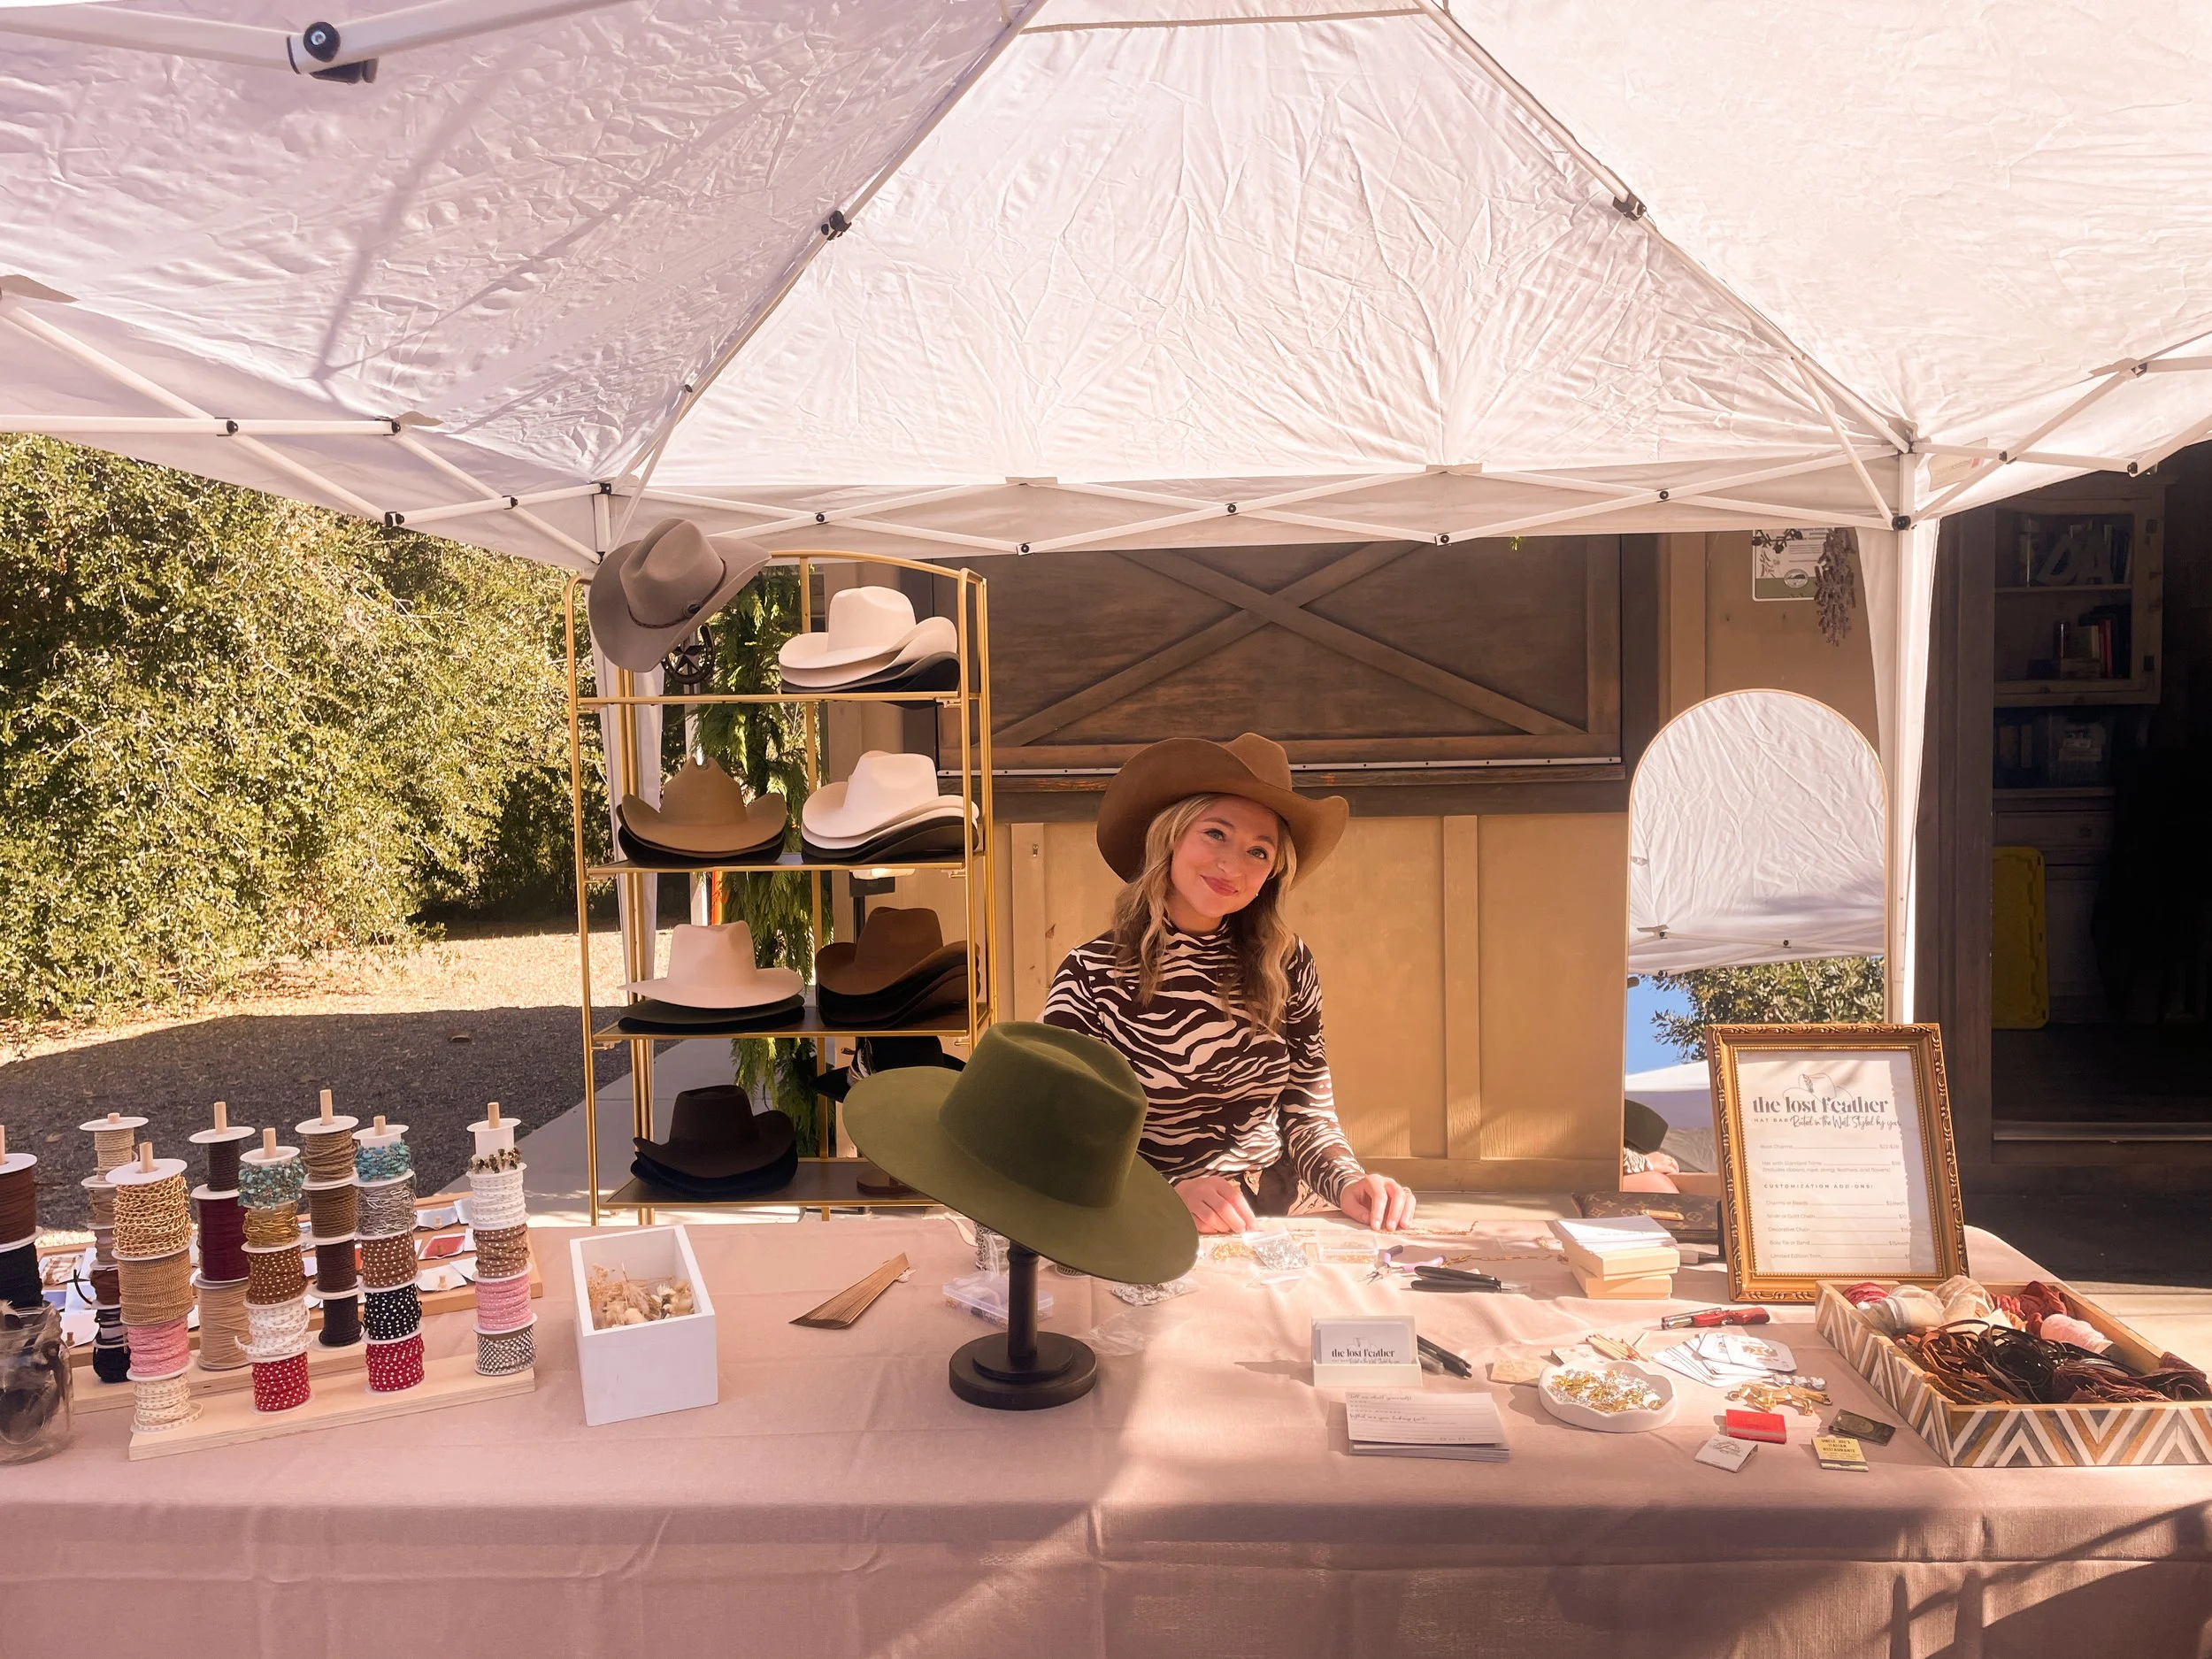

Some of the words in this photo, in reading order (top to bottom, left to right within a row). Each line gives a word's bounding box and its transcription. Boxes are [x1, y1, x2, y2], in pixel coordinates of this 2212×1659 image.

[1753, 1096, 1781, 1113] the
[1786, 1096, 1817, 1113] lost
[1822, 1096, 1888, 1113] feather
[1790, 1115, 1813, 1127] Rooted
[1332, 1348, 1344, 1357] the
[1347, 1348, 1362, 1357] lost
[1363, 1348, 1395, 1357] feather
